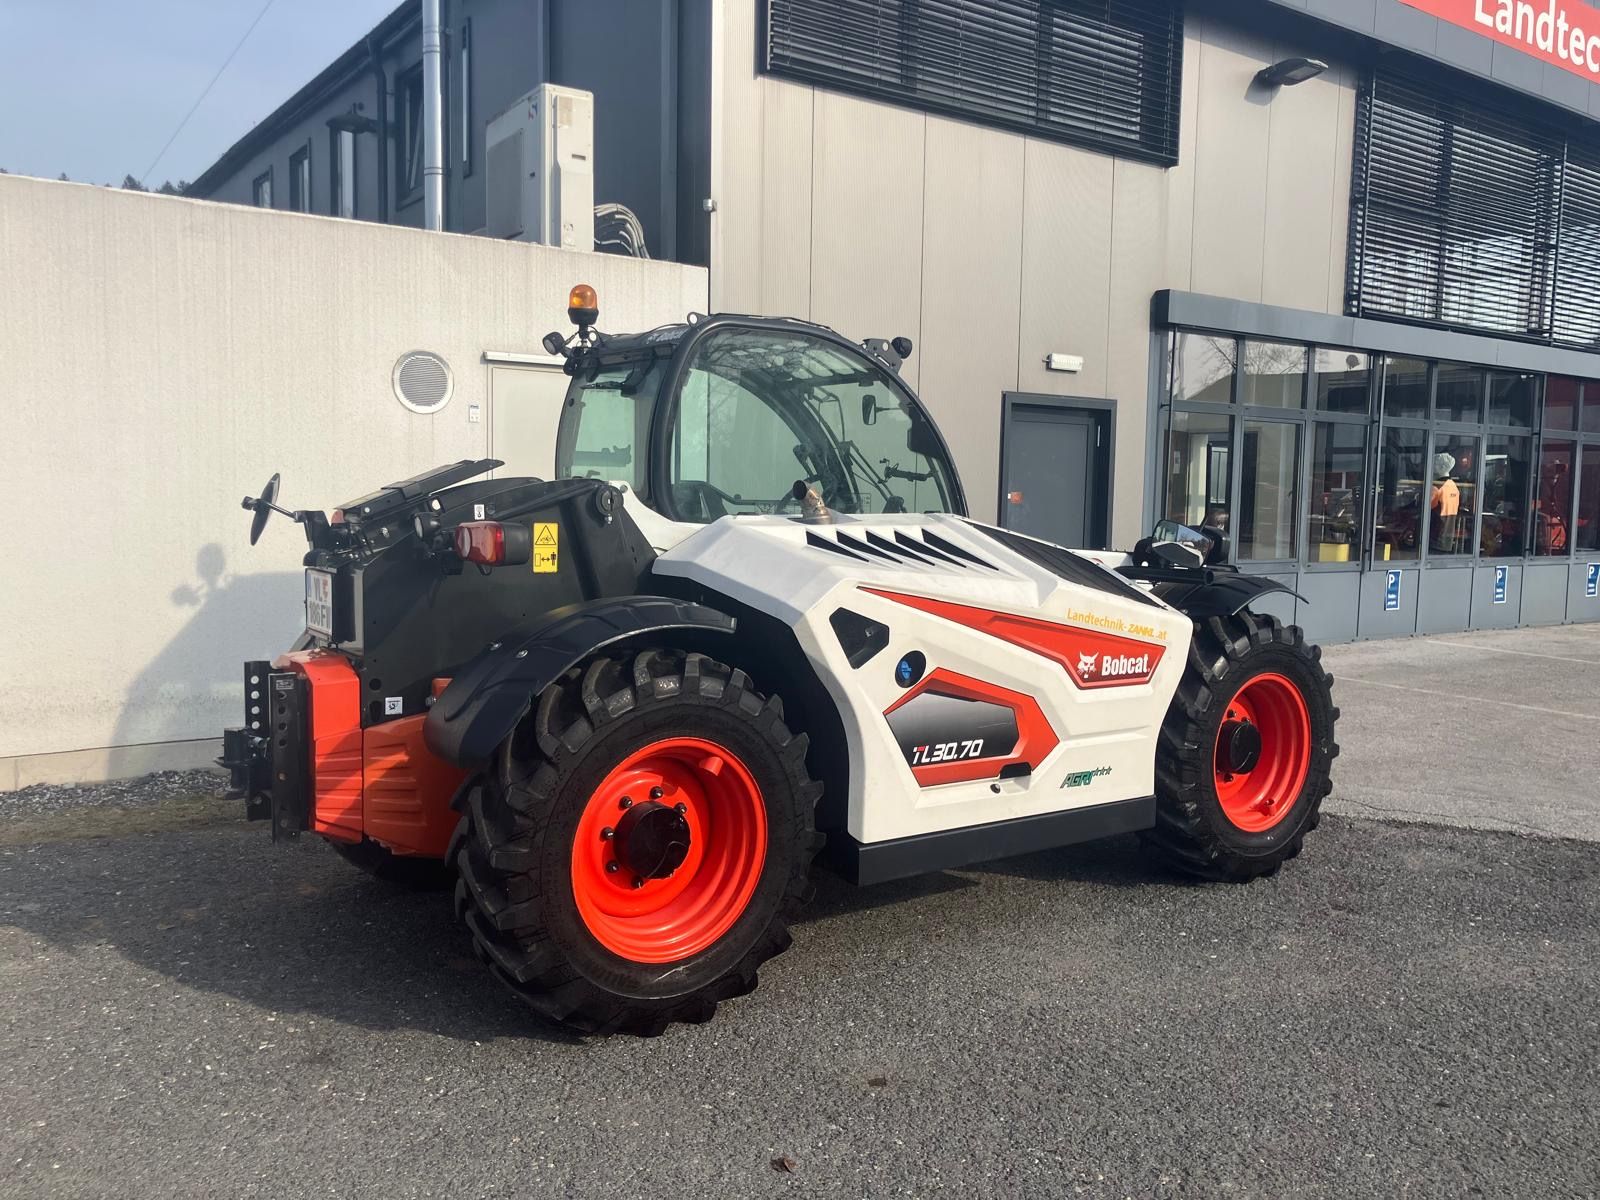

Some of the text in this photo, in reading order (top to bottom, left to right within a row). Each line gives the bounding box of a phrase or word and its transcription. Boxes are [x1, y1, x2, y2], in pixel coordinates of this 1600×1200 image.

[1497, 569, 1503, 584] P
[1588, 566, 1595, 579] P
[1388, 574, 1396, 589] P
[1101, 653, 1150, 676] Bobcat
[912, 739, 984, 765] TL30.70
